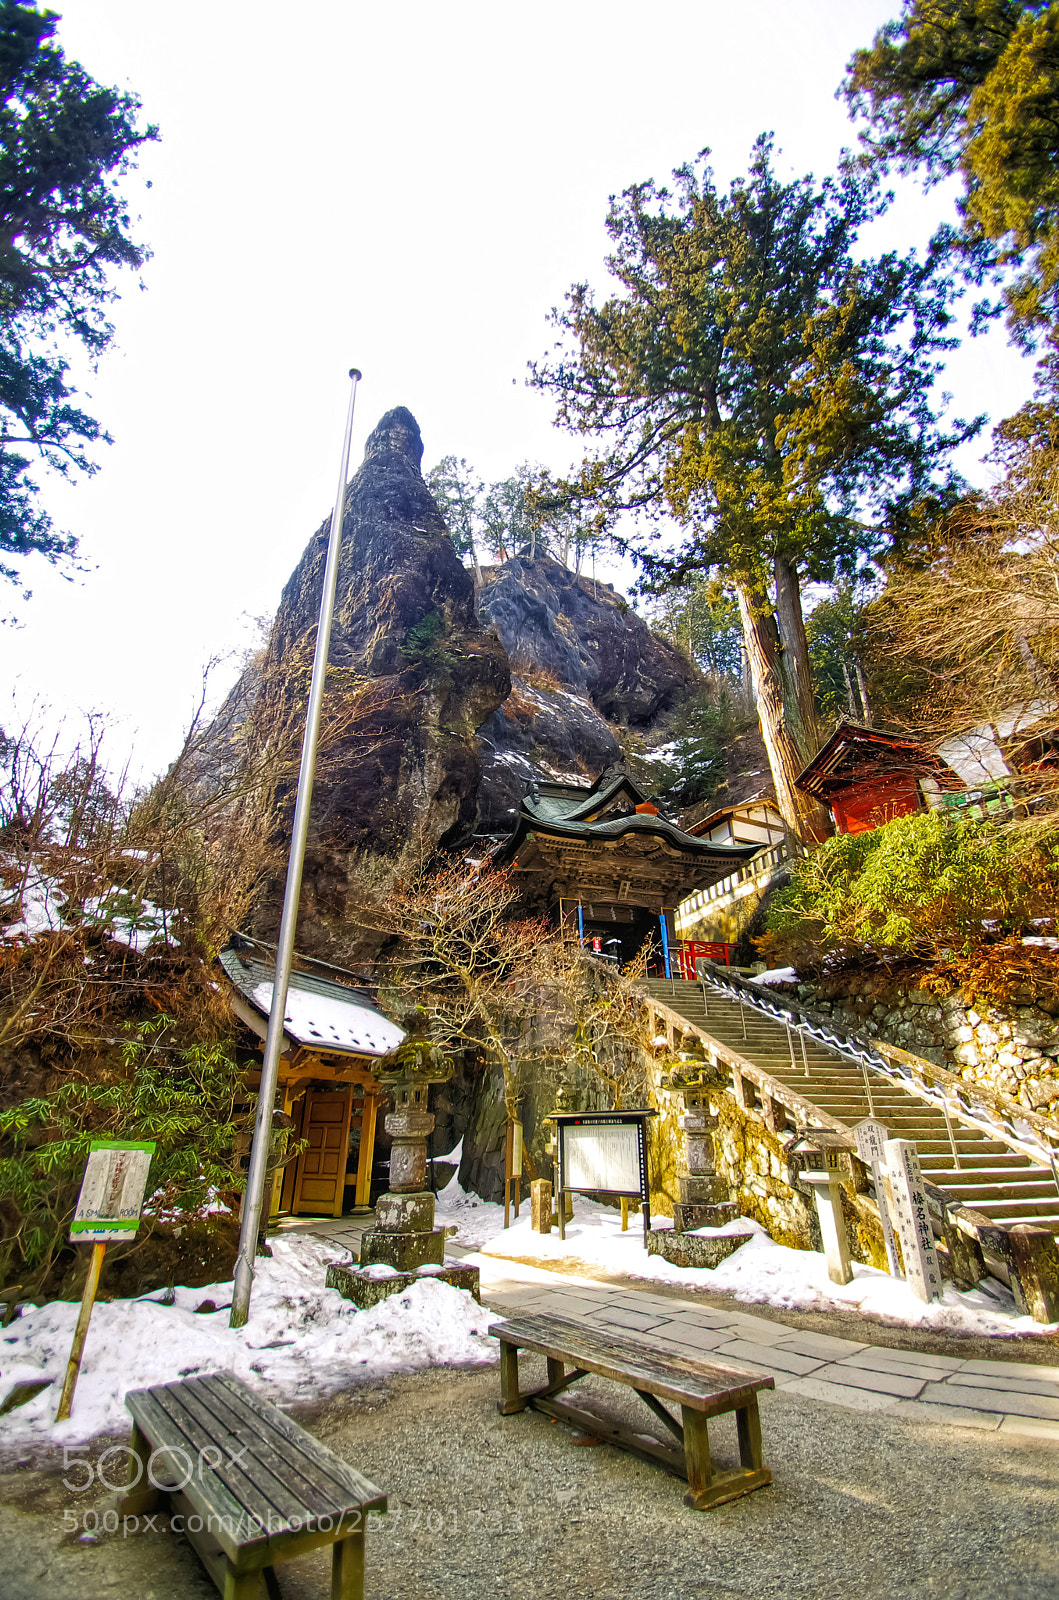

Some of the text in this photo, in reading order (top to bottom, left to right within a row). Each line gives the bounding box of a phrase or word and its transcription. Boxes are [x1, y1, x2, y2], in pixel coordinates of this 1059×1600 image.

[867, 1125, 879, 1157] 双龍門
[912, 1191, 933, 1251] 榛名神社
